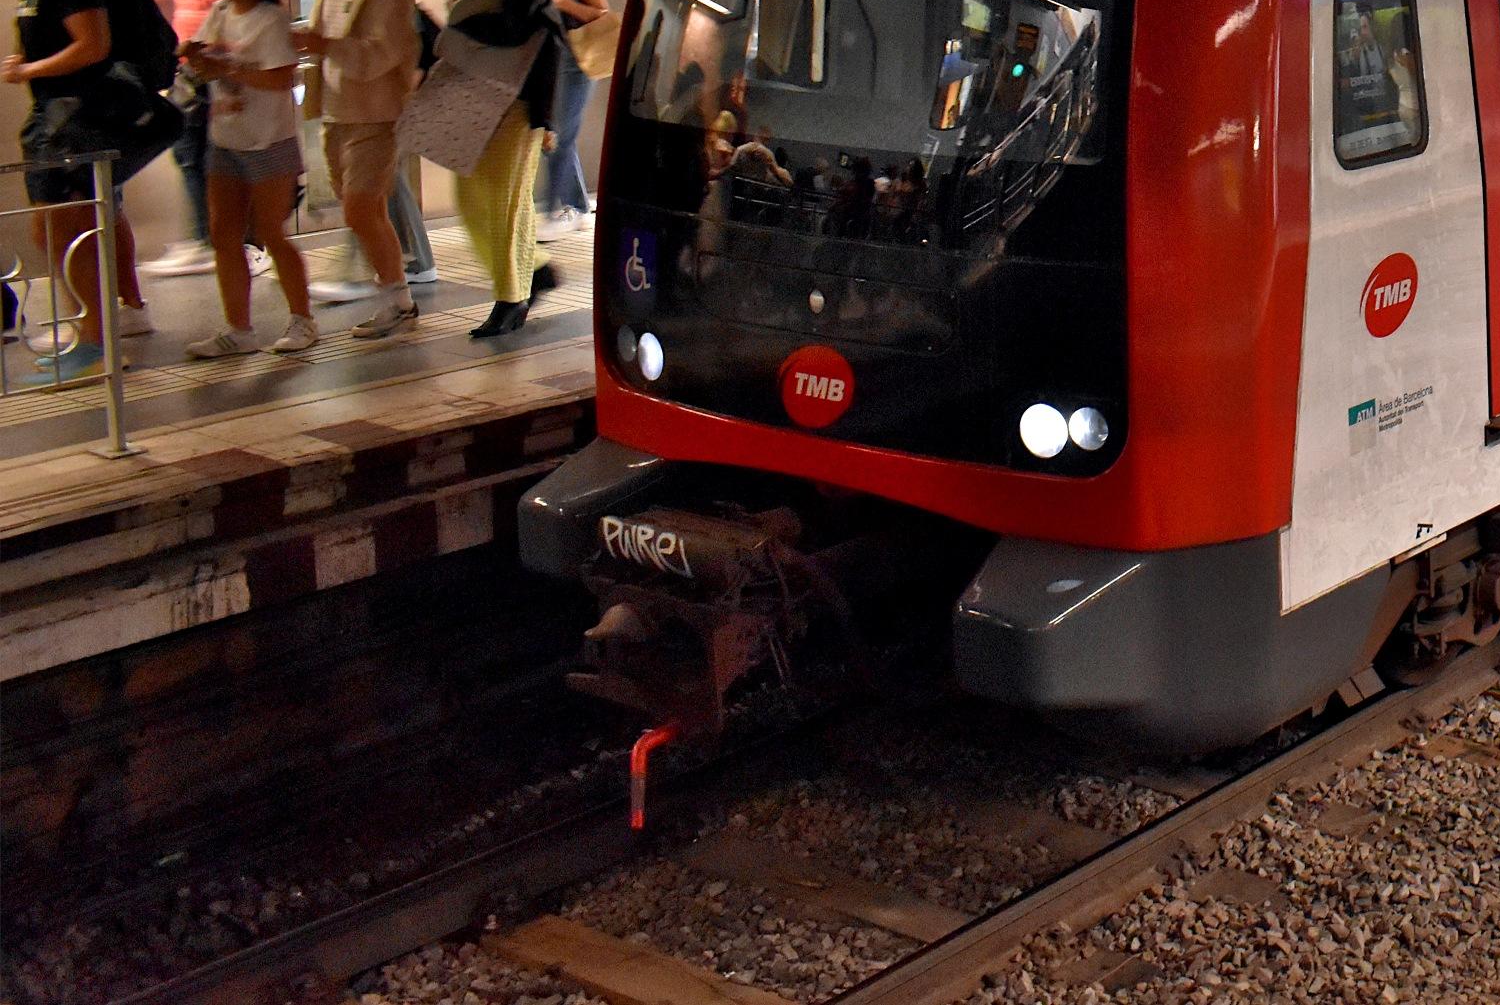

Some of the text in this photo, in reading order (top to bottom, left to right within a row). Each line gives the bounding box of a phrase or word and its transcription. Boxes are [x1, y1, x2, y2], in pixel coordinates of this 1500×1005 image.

[1374, 278, 1412, 311] TMB
[795, 371, 847, 403] TMB
[1394, 397, 1402, 408] de
[1403, 385, 1433, 404] Barcelona
[1357, 406, 1374, 423] ATM
